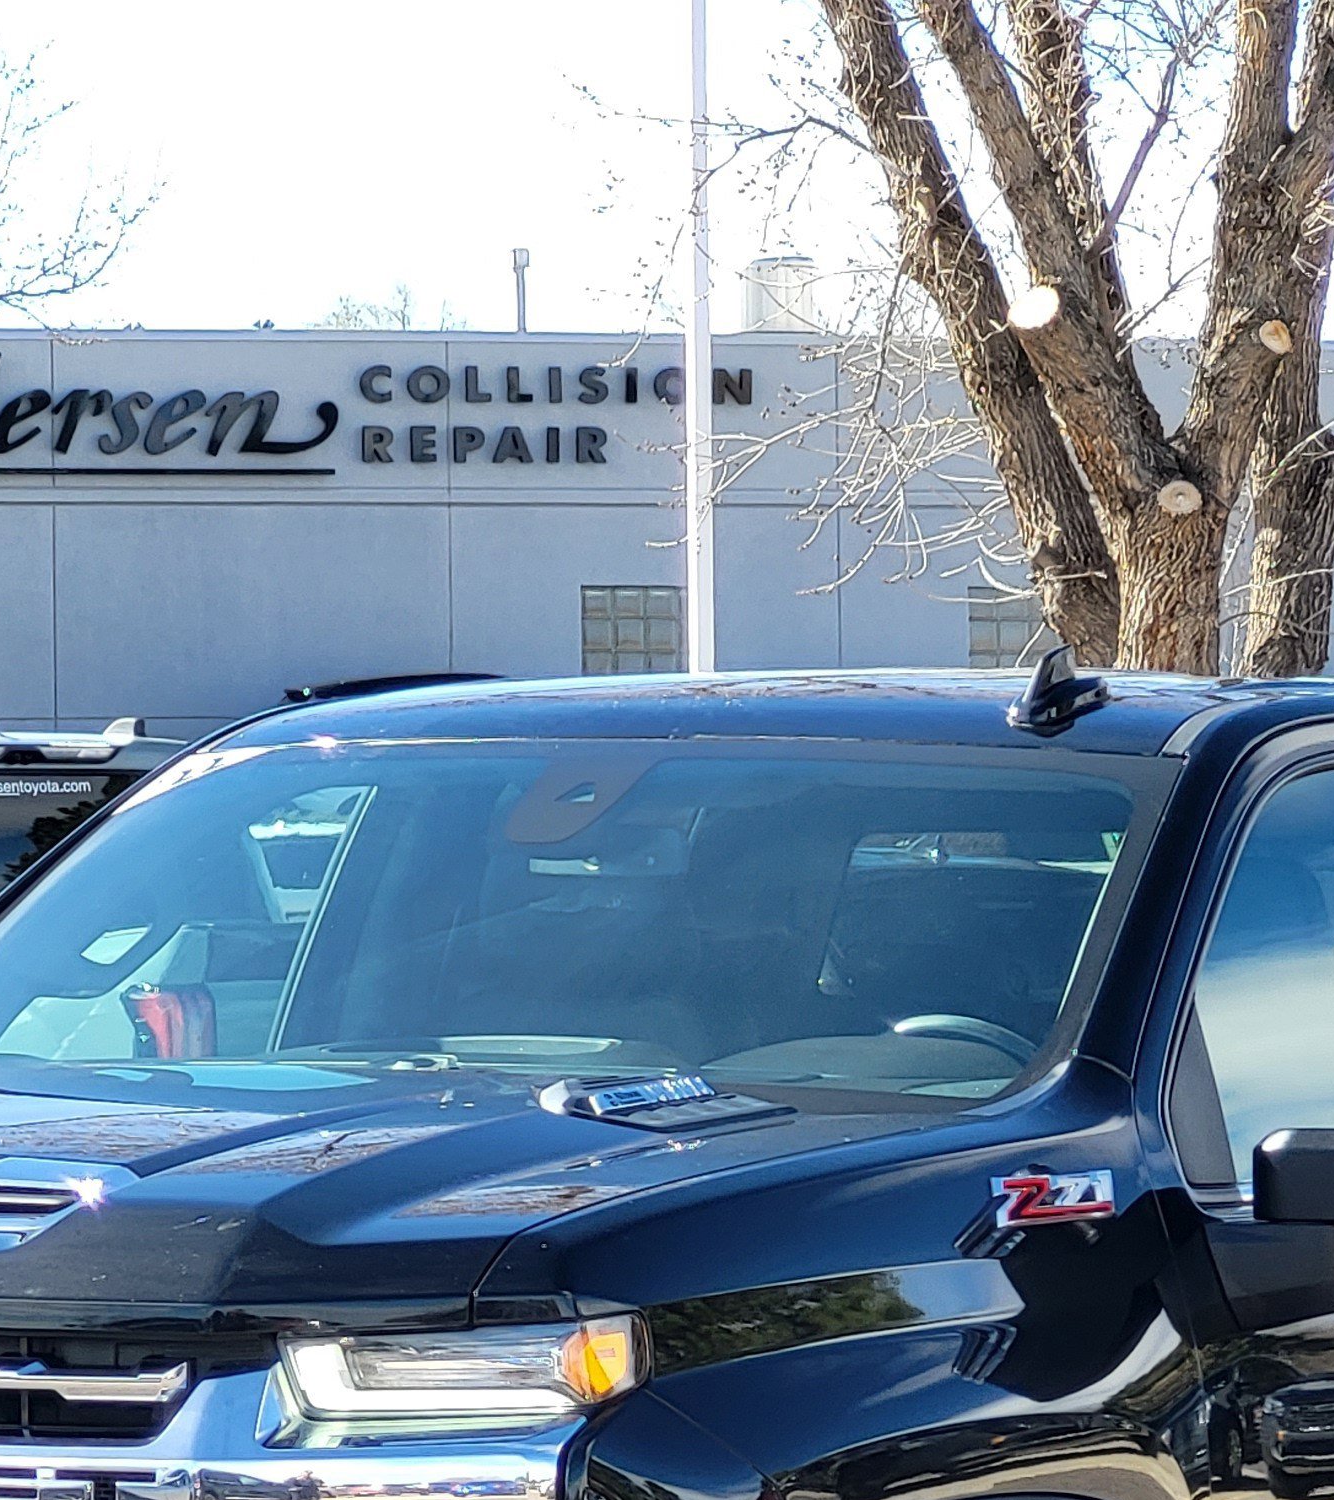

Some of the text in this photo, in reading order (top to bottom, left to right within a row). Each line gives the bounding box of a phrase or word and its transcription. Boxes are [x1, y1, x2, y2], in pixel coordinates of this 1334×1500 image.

[359, 364, 753, 406] COLLISION
[359, 425, 608, 465] REPAIR
[990, 1168, 1116, 1229] Z71
